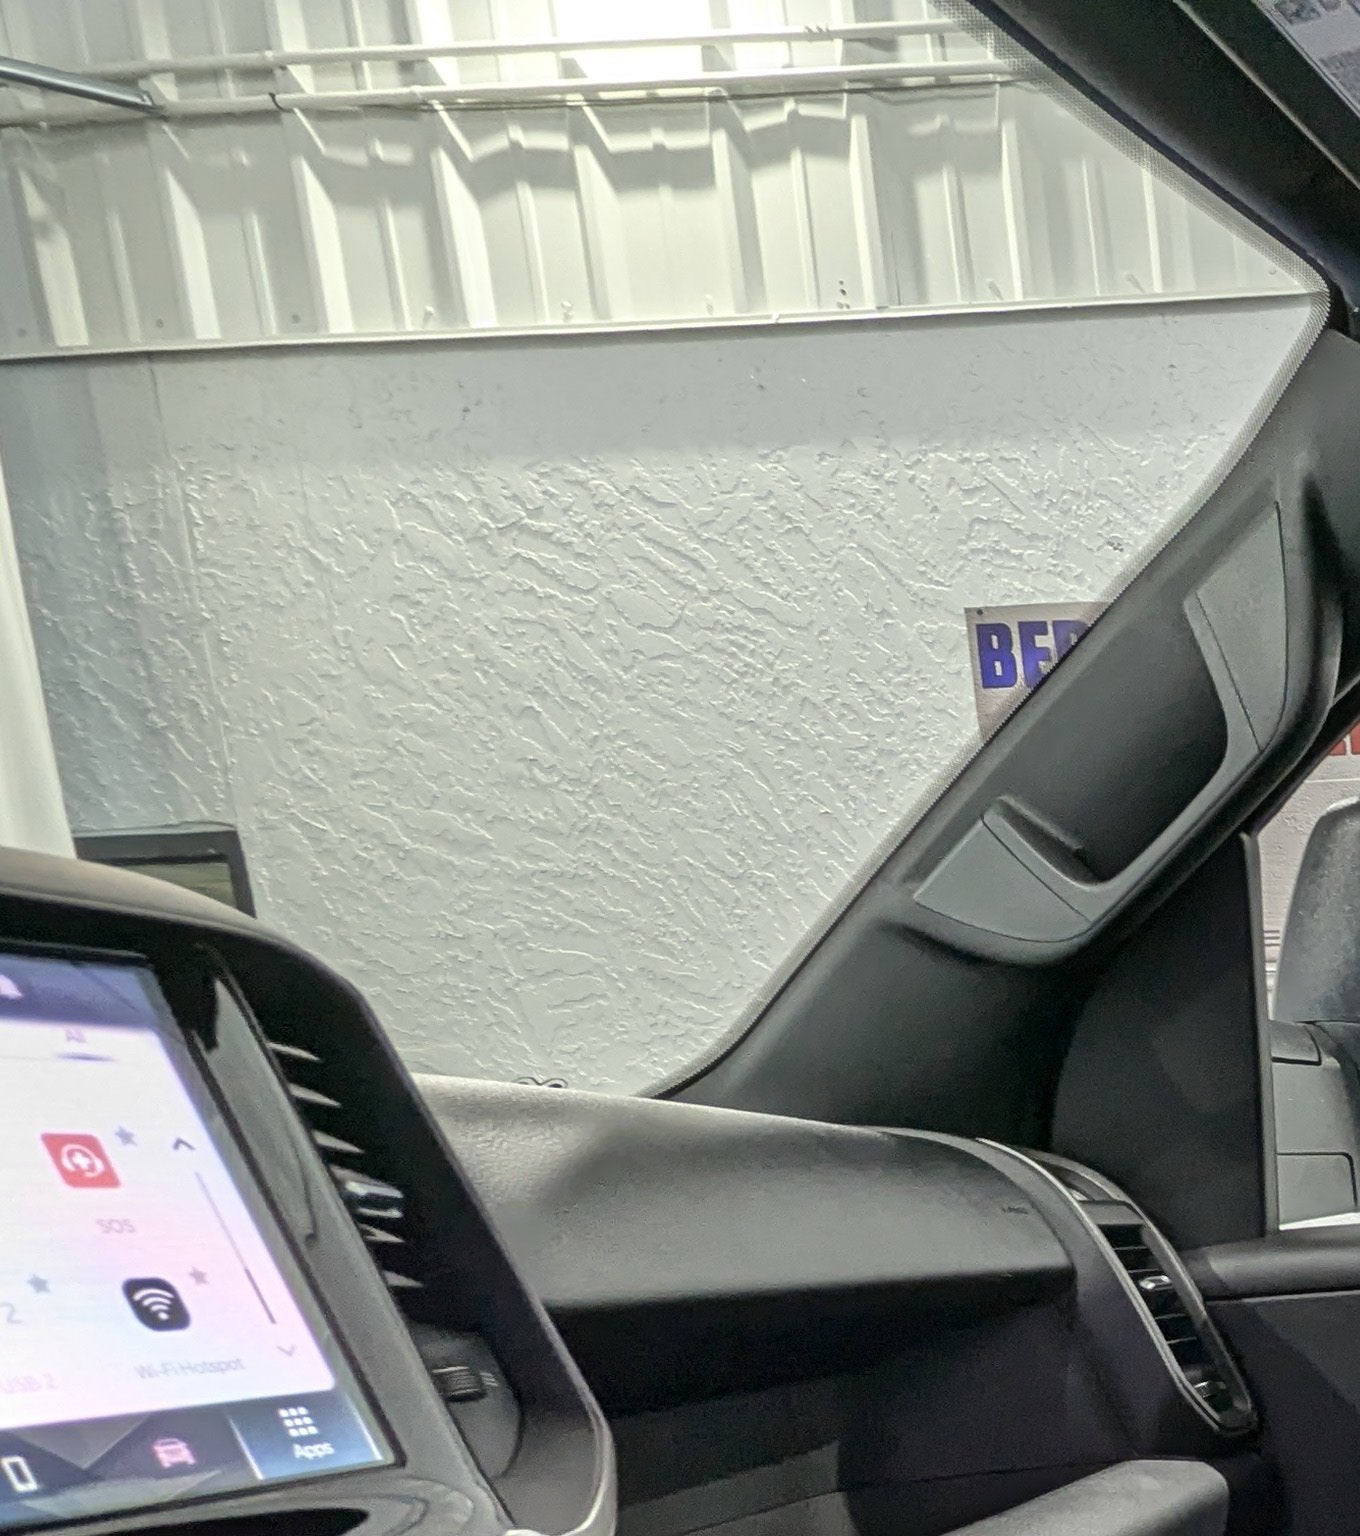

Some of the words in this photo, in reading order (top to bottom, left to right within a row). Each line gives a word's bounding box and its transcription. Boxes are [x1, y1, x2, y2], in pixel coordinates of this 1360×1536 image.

[96, 1217, 137, 1235] SOS
[133, 1361, 180, 1380] Wi-Fi
[182, 1357, 246, 1376] Hotspot
[292, 1441, 335, 1460] Apps
